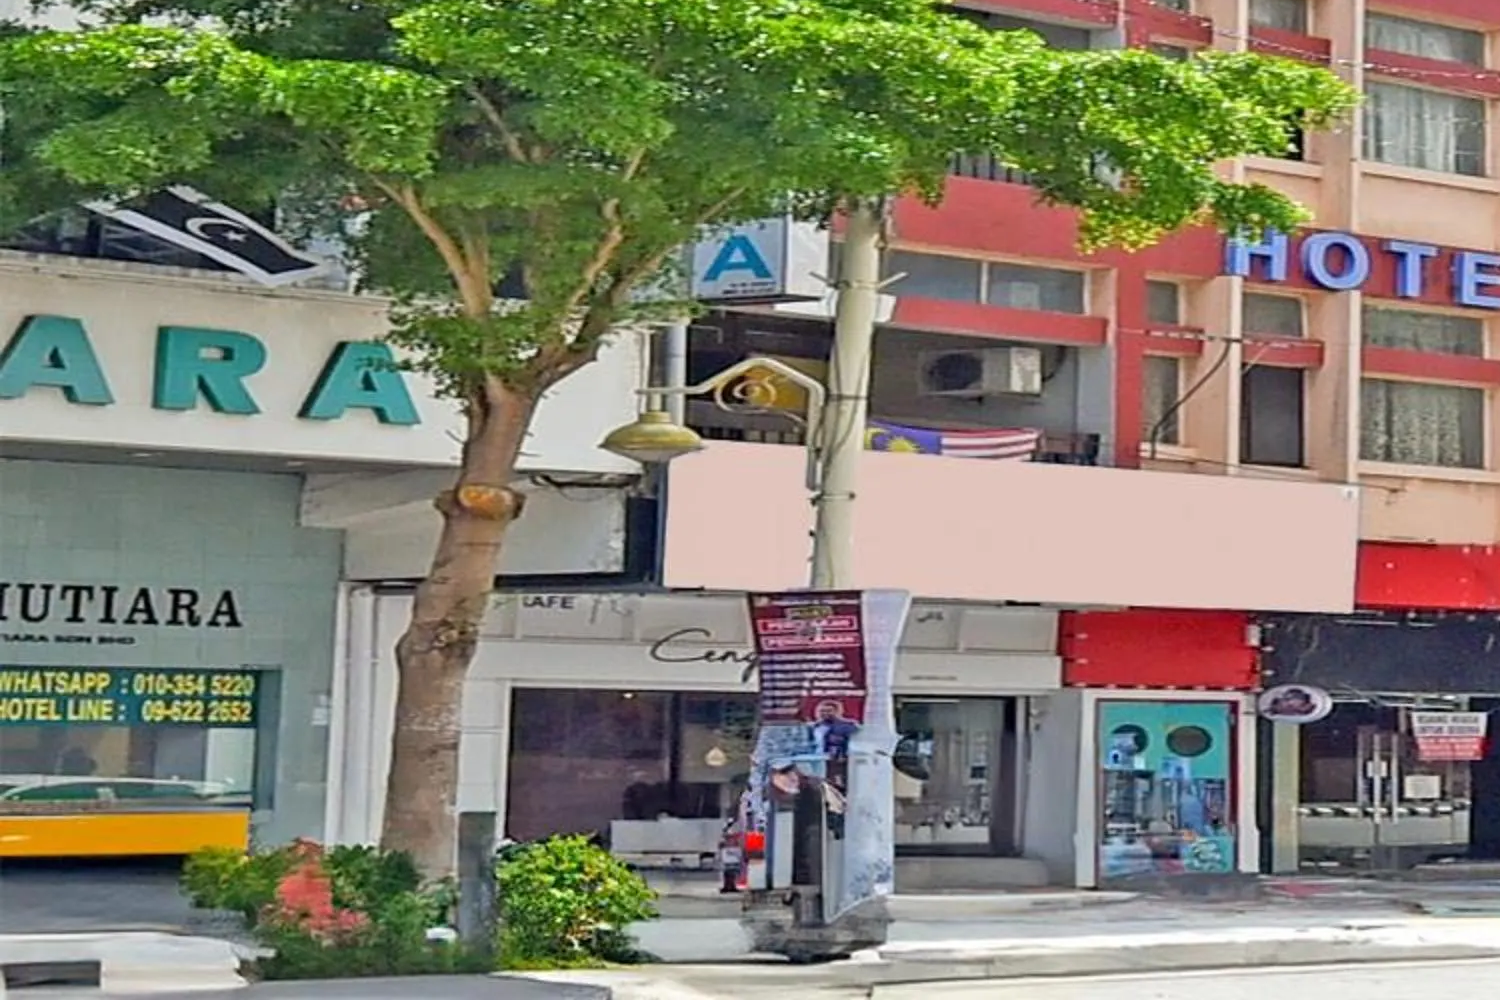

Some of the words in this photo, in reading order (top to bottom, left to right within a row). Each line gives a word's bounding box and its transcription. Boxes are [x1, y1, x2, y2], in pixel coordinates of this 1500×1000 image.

[0, 582, 243, 628] UTIARA
[0, 671, 111, 695] WHATSAPP
[67, 698, 113, 721] LINE
